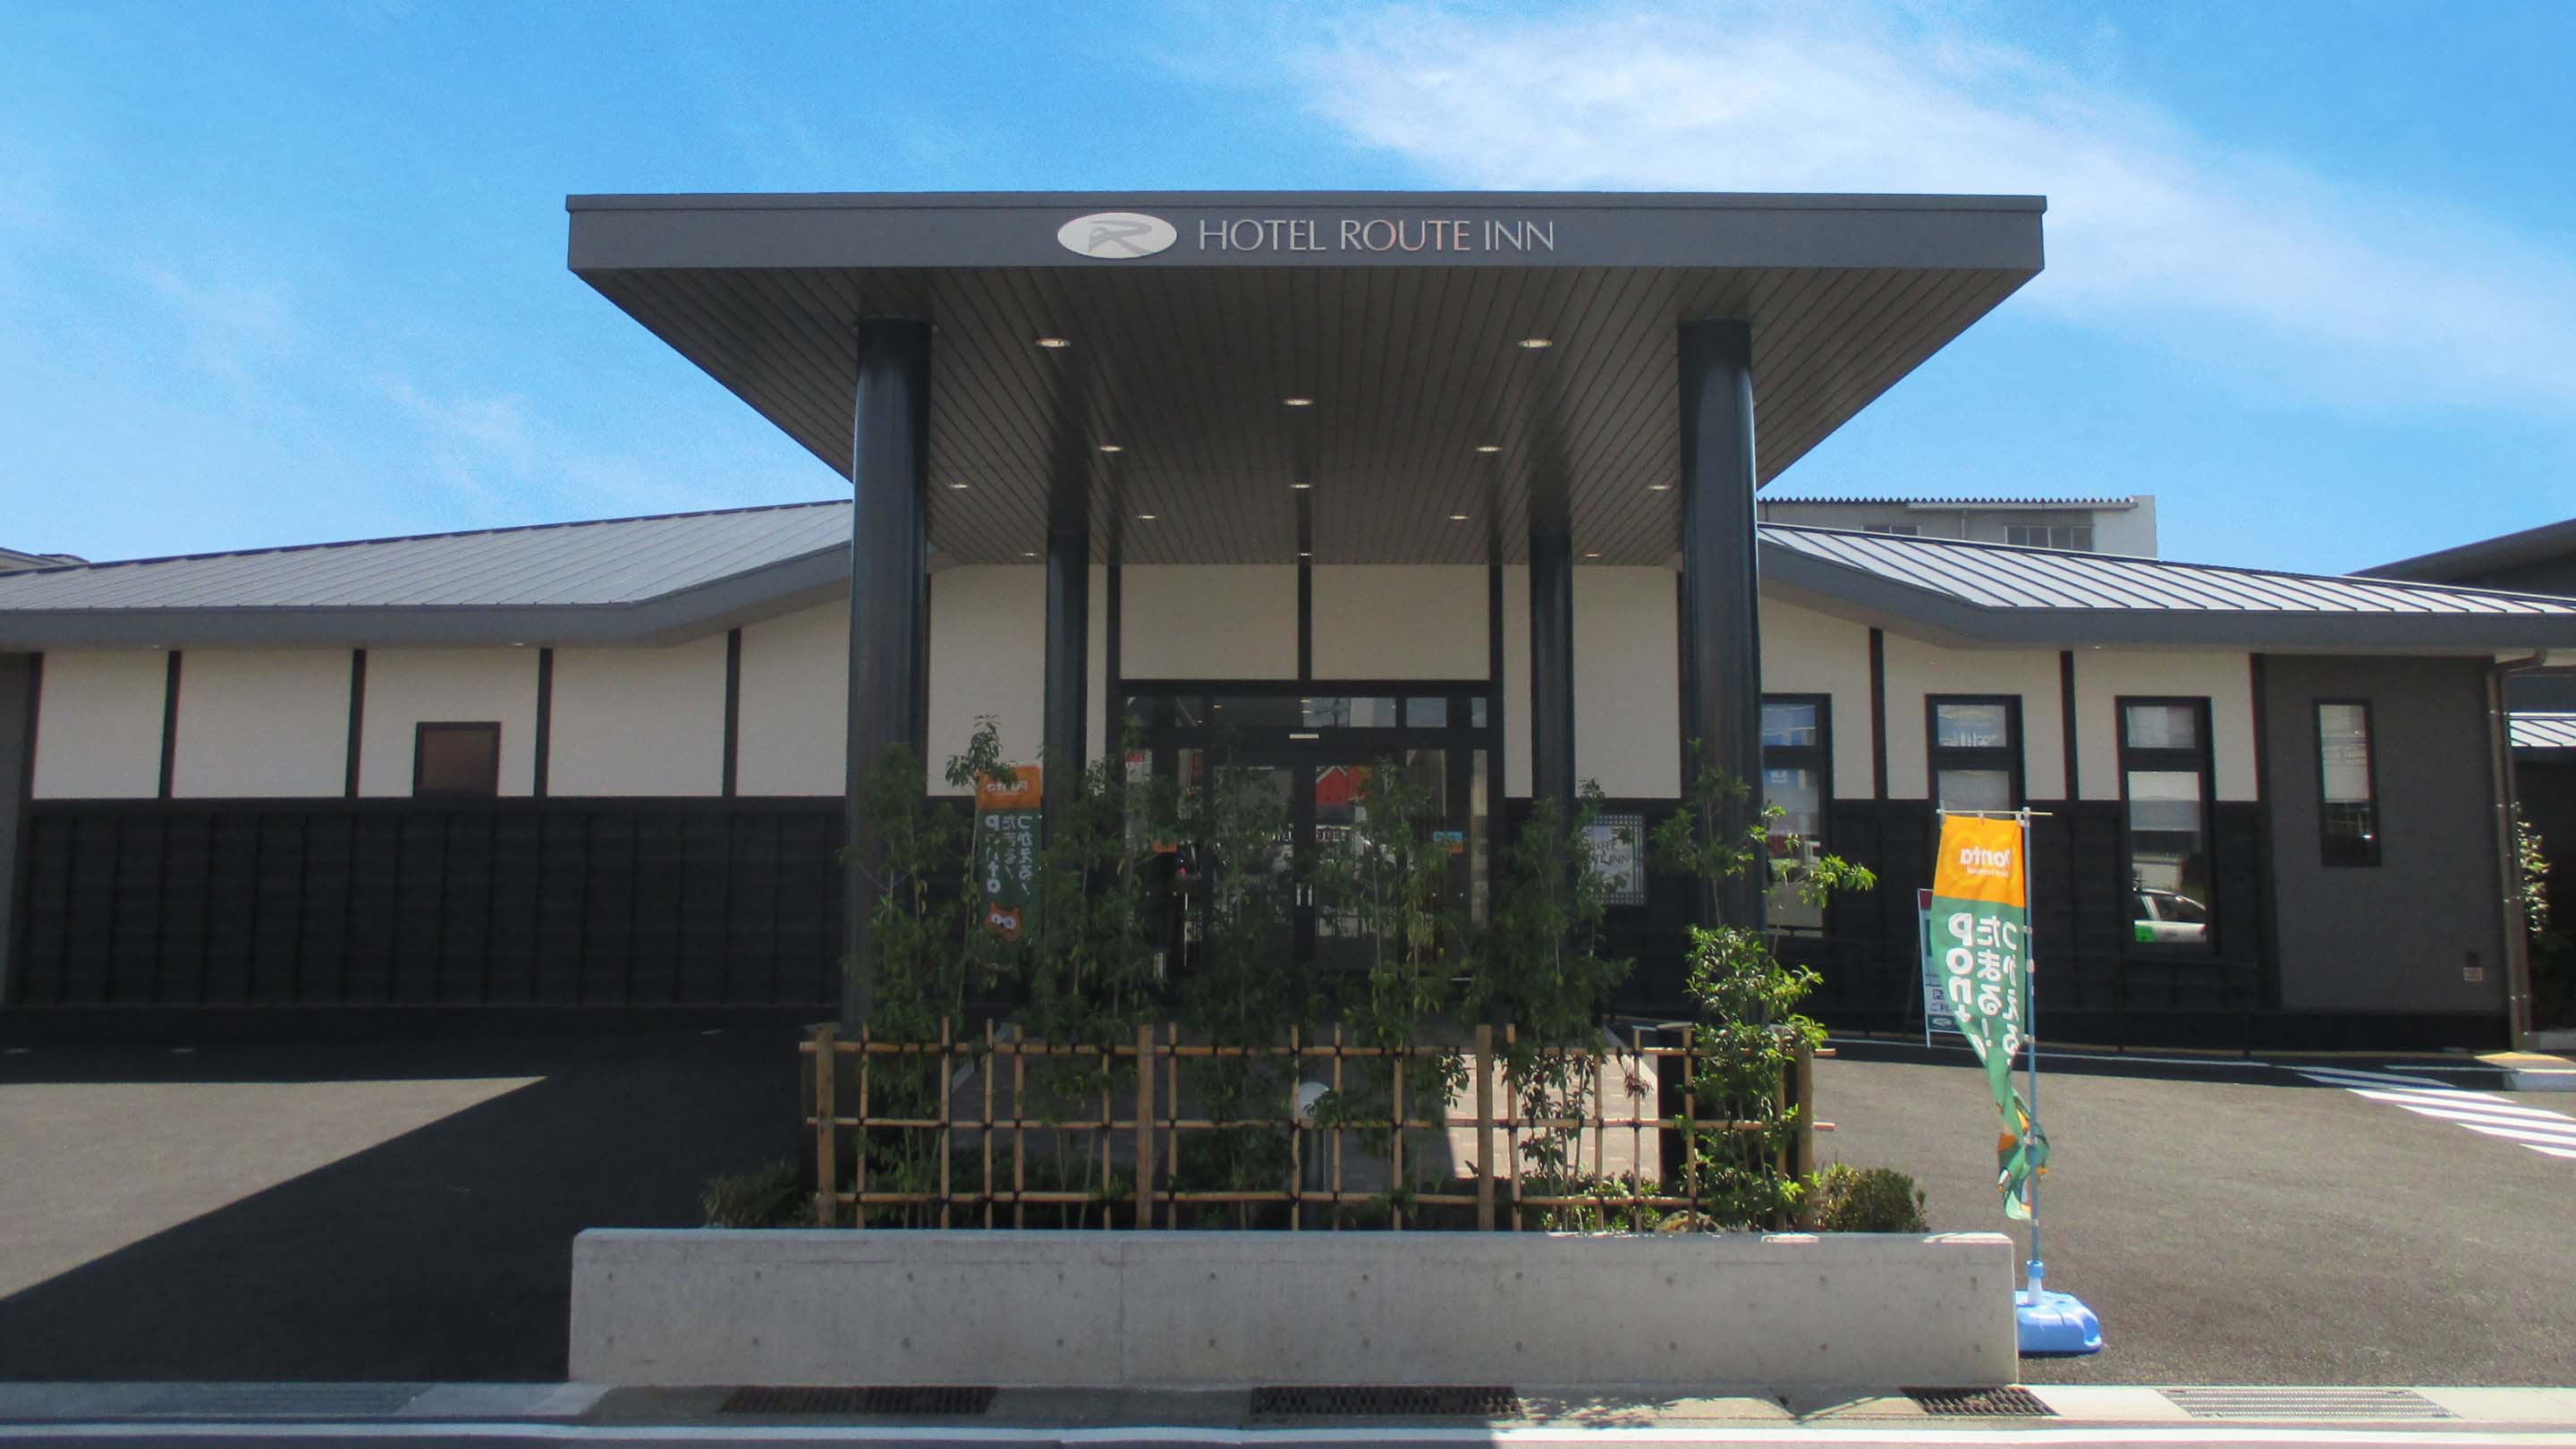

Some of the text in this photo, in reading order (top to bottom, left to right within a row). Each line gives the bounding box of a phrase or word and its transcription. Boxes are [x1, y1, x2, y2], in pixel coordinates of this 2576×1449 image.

[1199, 219, 1555, 252] HOTEL ROUTE INN
